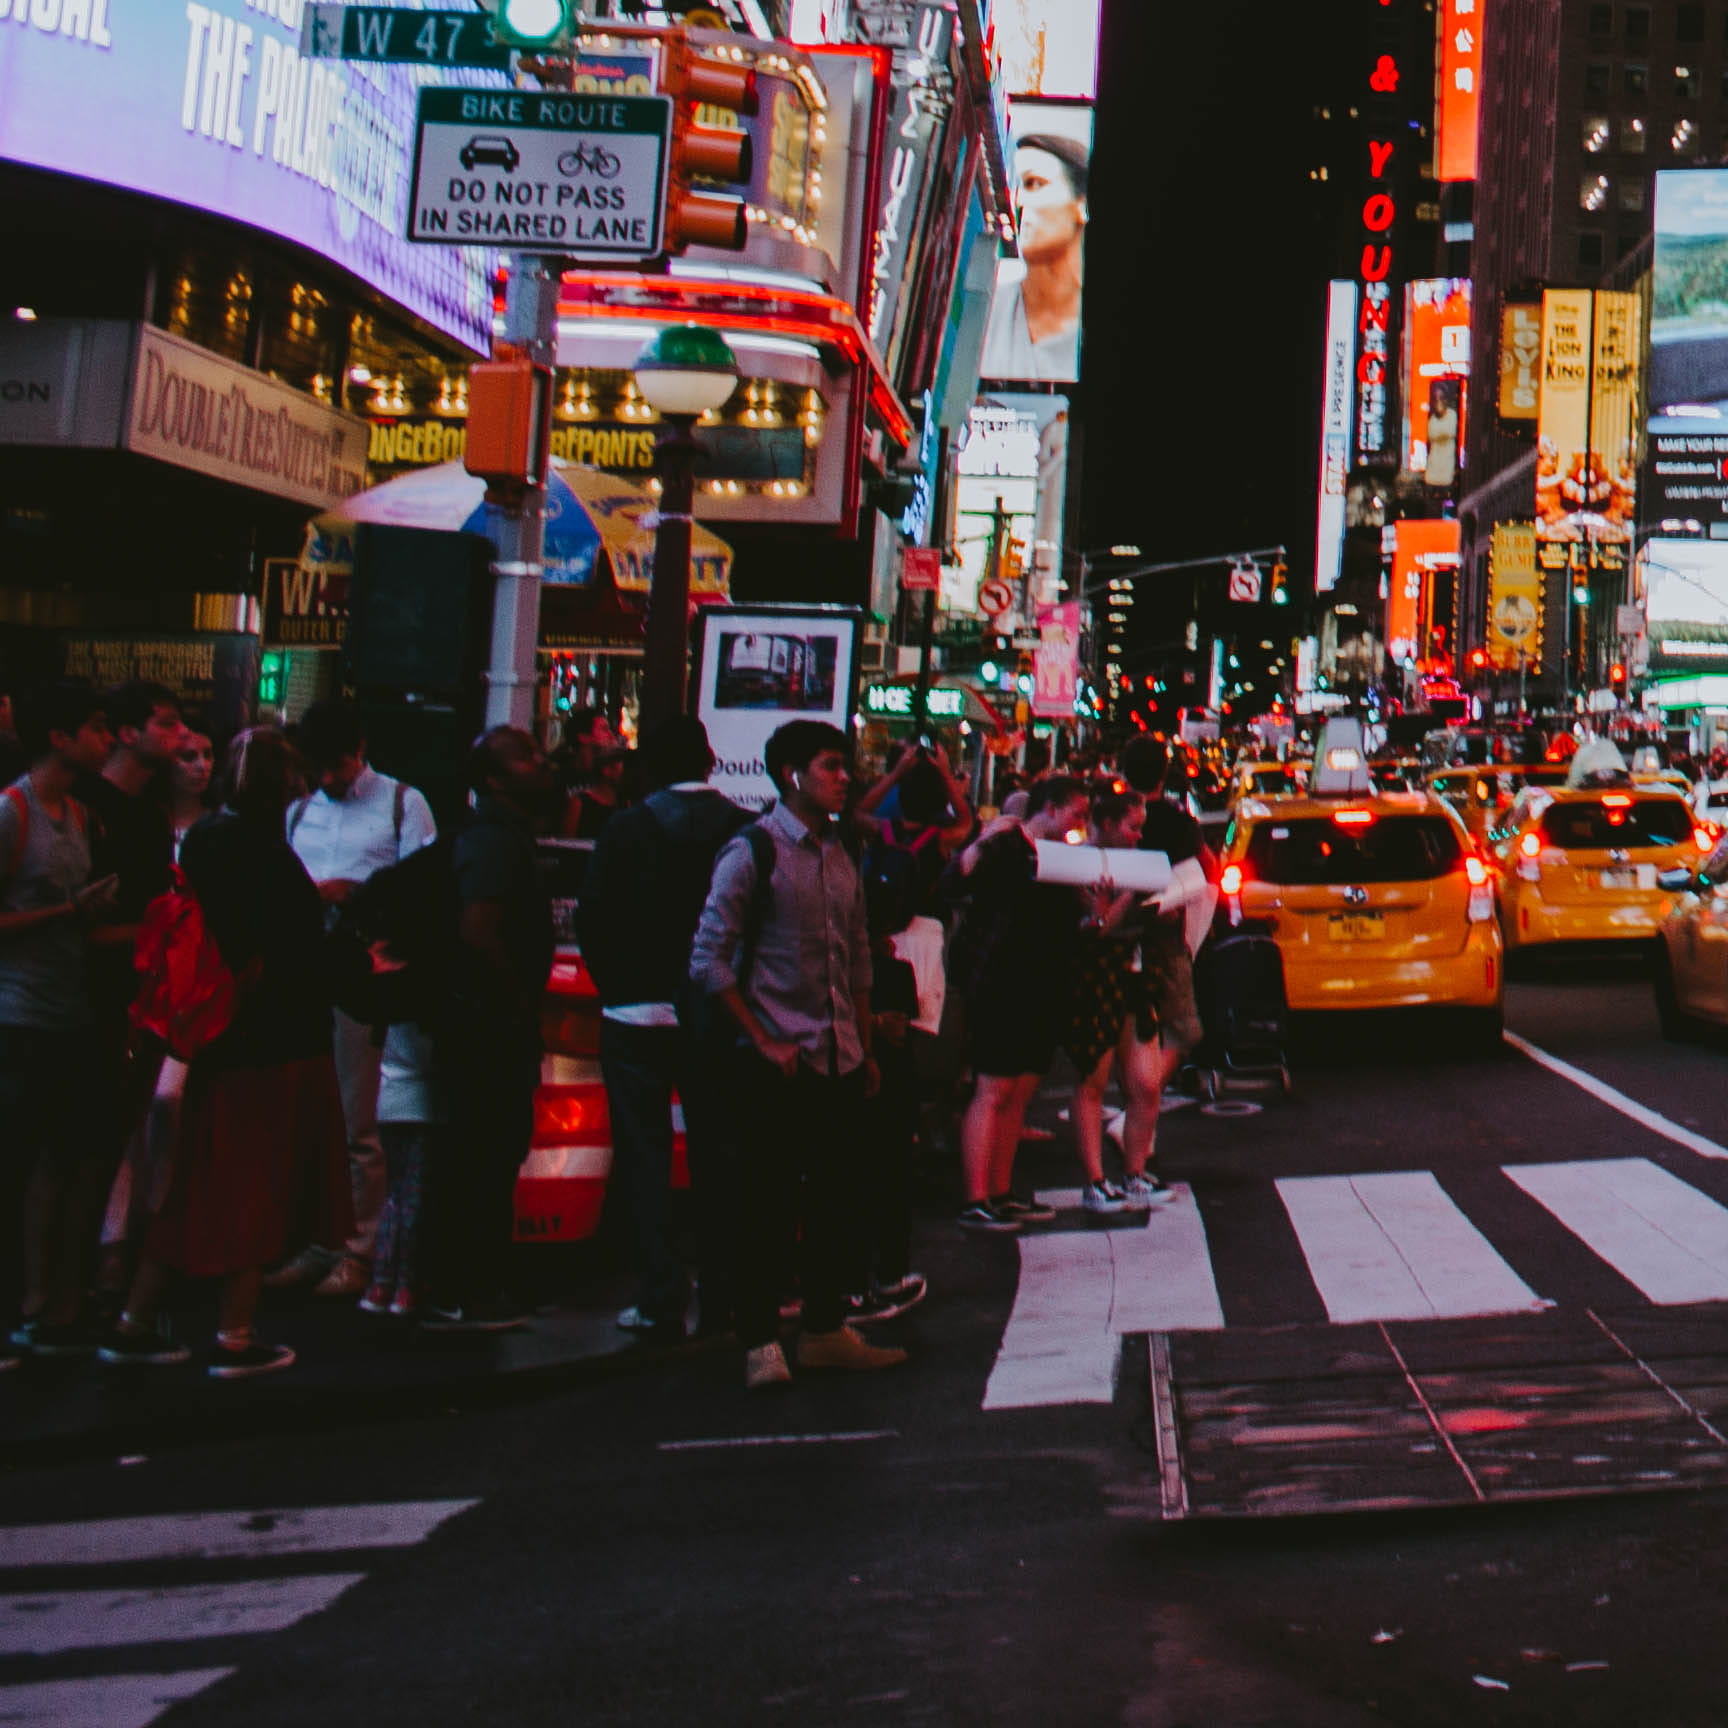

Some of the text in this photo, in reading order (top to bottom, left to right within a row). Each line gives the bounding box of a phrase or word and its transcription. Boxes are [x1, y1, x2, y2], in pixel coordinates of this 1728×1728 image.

[357, 11, 498, 61] W 47 S
[181, 1, 254, 150] THE
[1370, 54, 1399, 93] &
[461, 92, 627, 128] BIKE ROUTE
[447, 177, 626, 210] DO NOT PASS
[420, 208, 647, 242] IN SHARED LANE
[1359, 141, 1394, 385] YOUNG
[1548, 337, 1582, 358] LION
[1554, 324, 1577, 337] THE
[1545, 359, 1585, 381] KING
[369, 419, 467, 463] ONGEBO
[555, 426, 656, 469] REPANTS
